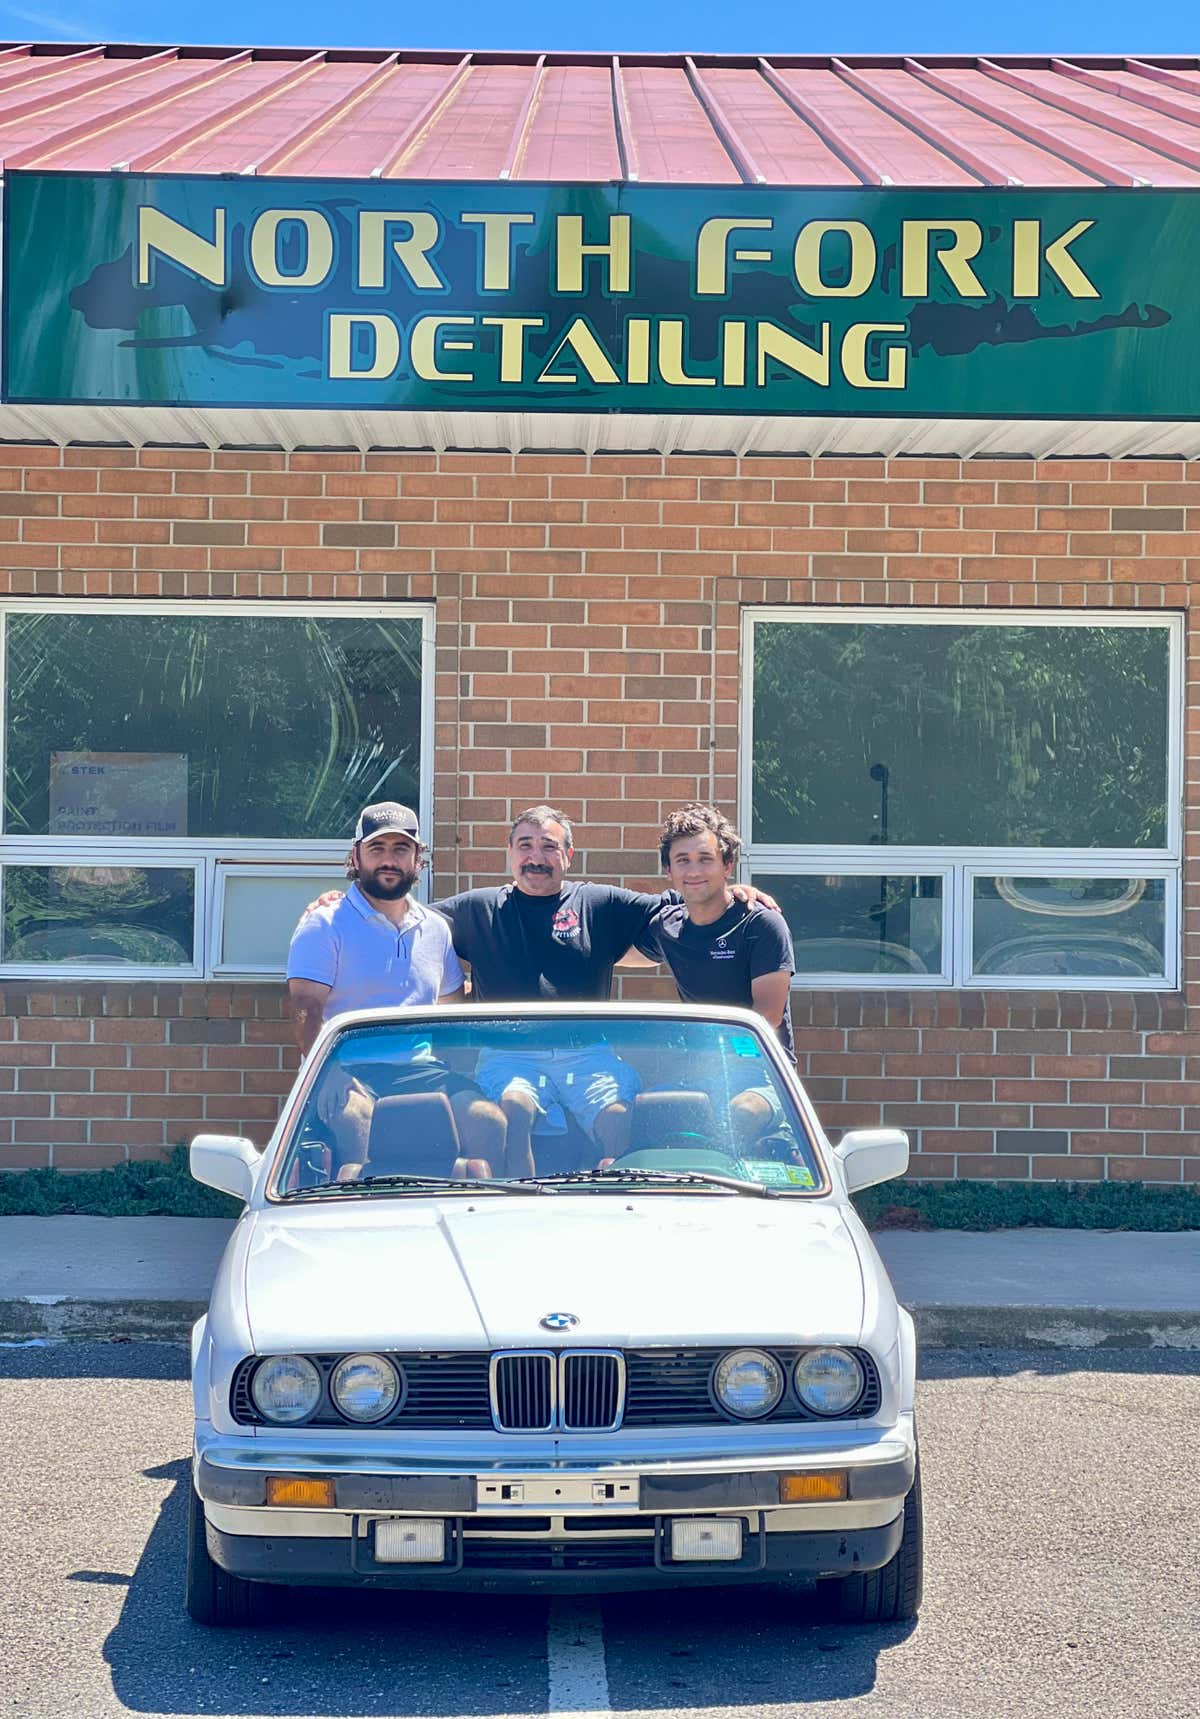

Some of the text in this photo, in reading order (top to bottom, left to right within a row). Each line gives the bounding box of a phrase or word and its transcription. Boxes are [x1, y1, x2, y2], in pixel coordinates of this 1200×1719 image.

[138, 206, 1102, 298] NORTH FORK
[329, 314, 910, 390] DETAILING
[71, 766, 105, 775] STEK
[57, 806, 98, 816] PAINT
[57, 821, 176, 832] PROTECTION FILM
